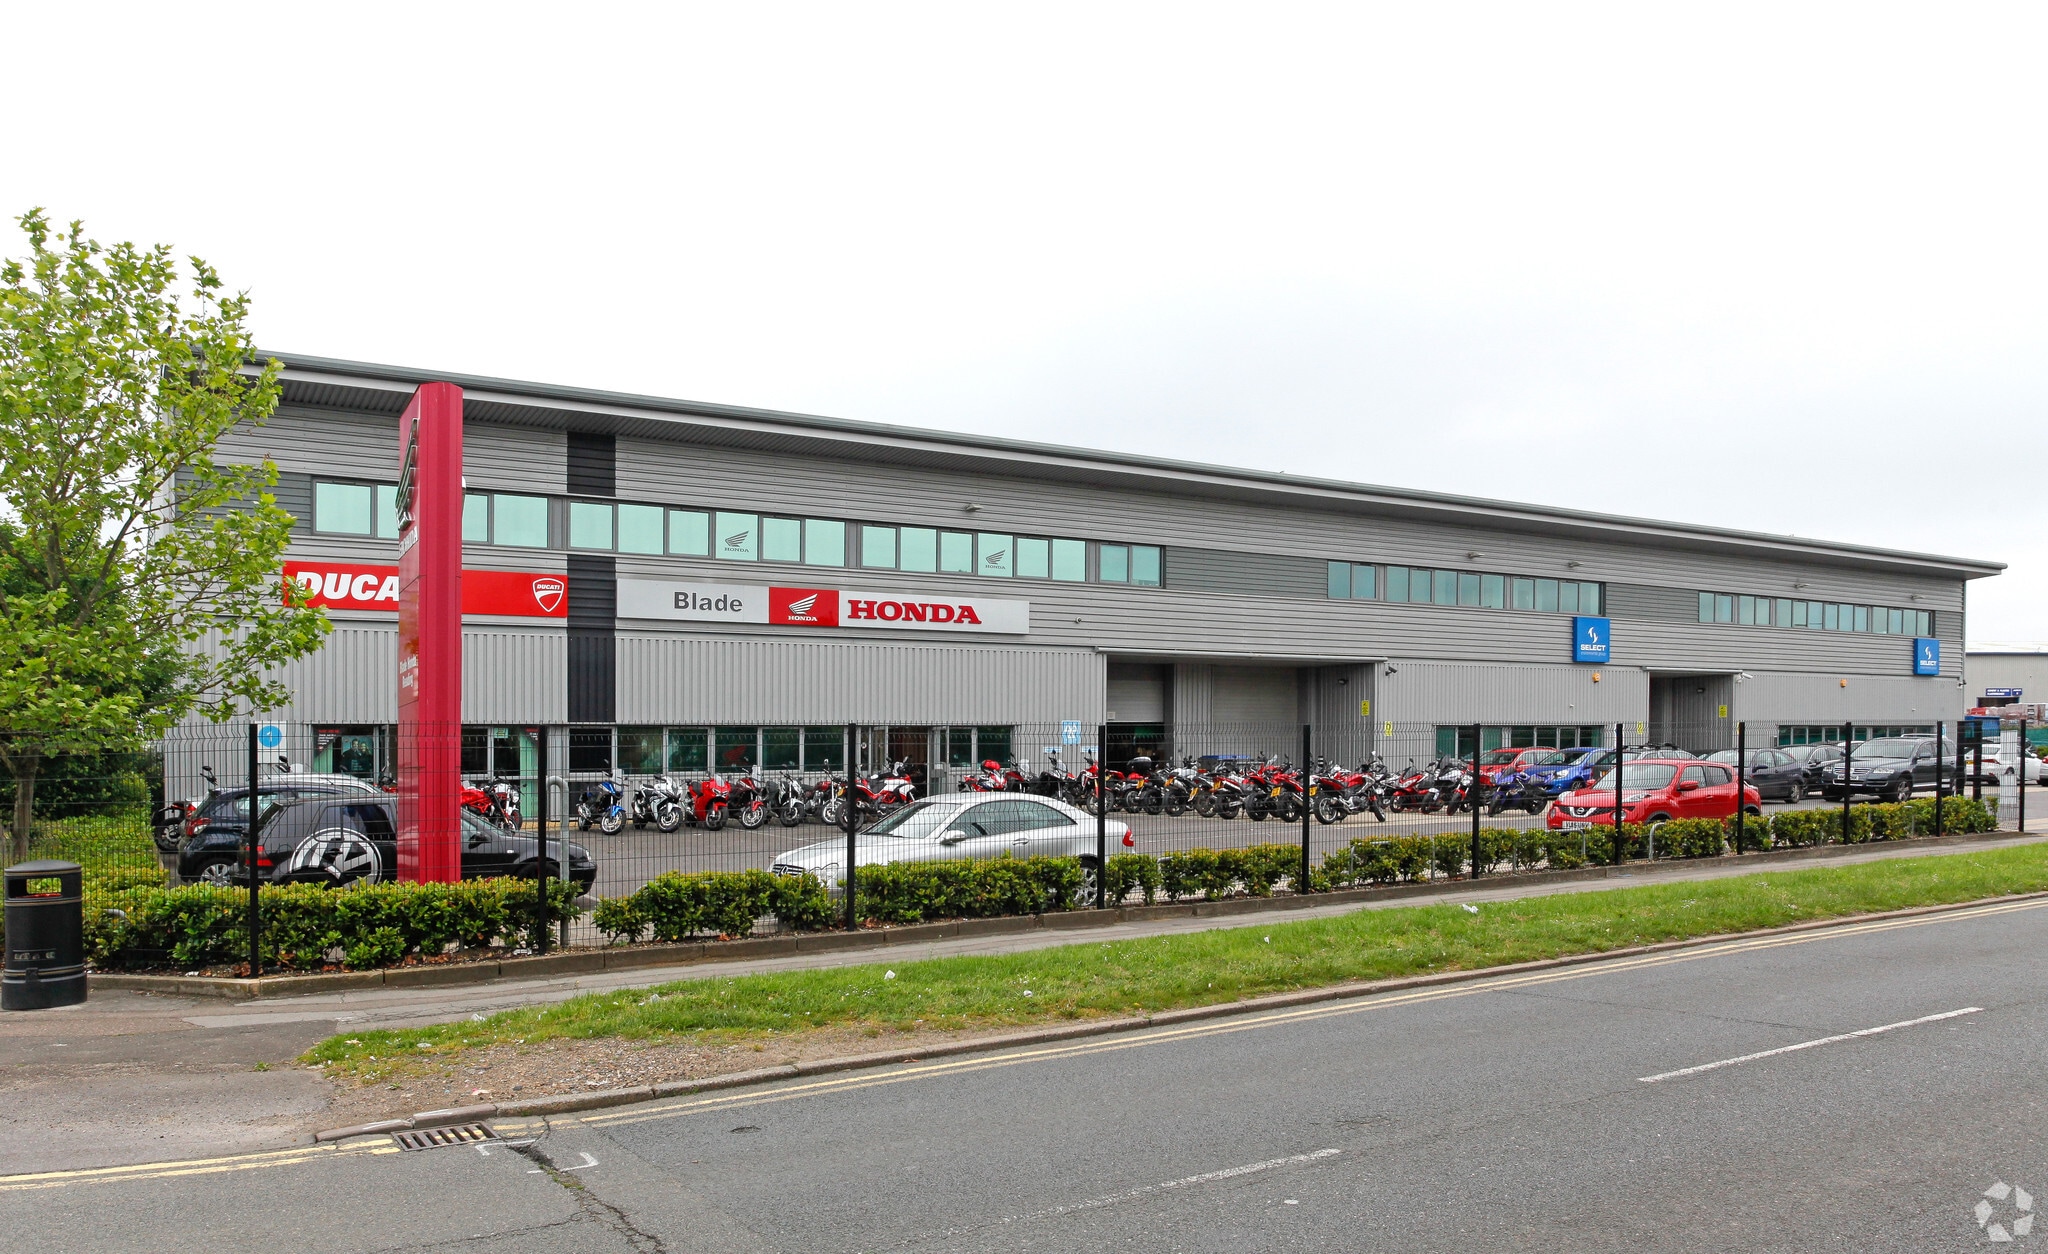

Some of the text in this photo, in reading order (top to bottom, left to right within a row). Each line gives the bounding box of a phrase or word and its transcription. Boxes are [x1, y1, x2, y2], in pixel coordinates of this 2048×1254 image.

[295, 571, 399, 602] DUCA
[673, 591, 743, 613] Blade
[848, 599, 982, 625] HONDA
[788, 614, 818, 623] HONDA
